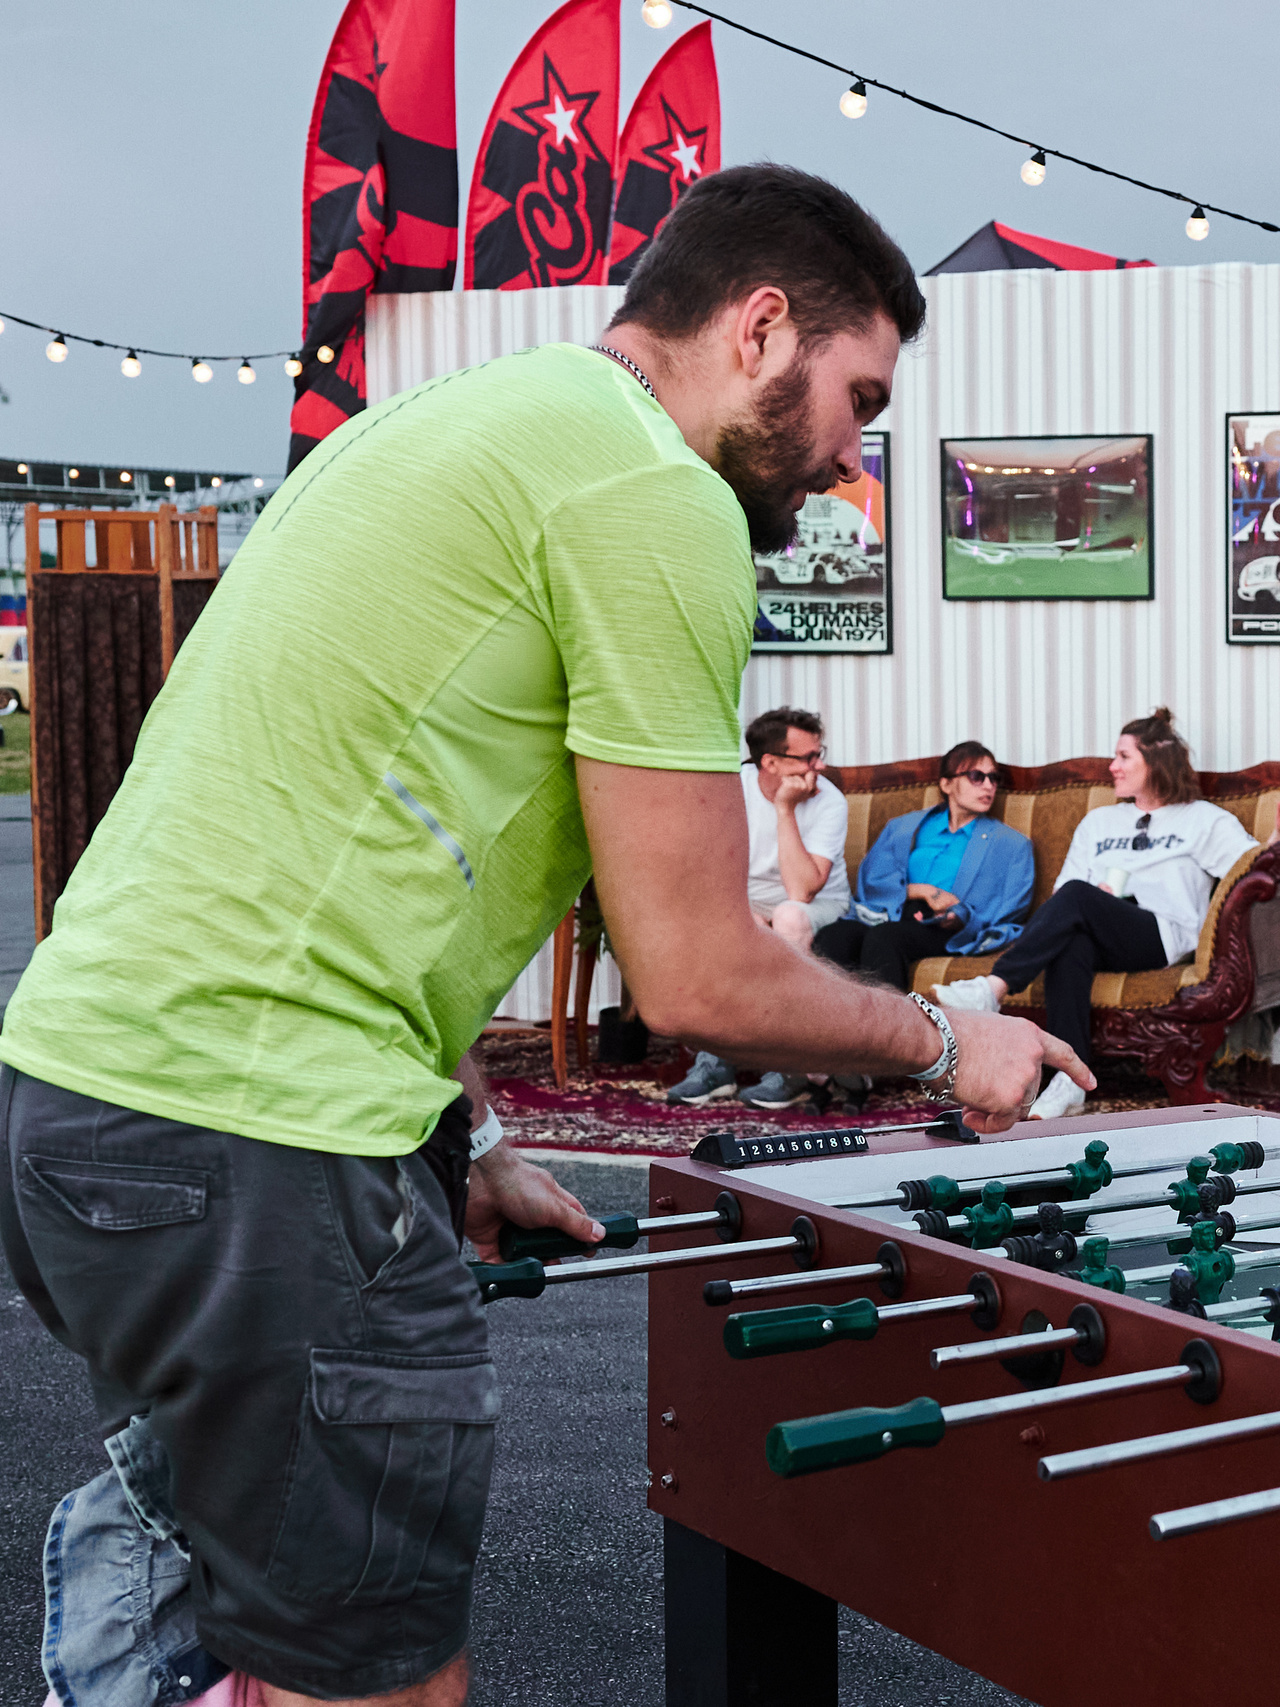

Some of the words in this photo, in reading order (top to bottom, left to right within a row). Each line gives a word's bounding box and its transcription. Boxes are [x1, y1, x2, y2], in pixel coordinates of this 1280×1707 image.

[769, 602, 796, 614] 24
[799, 602, 884, 614] HEURES
[790, 614, 819, 628] DU
[823, 614, 884, 628] MANS
[798, 629, 842, 641] JUIN
[844, 629, 884, 641] 1971
[738, 1147, 746, 1157] 1
[751, 1145, 760, 1156] 2
[765, 1144, 774, 1154] 3
[778, 1143, 786, 1153] 4
[790, 1141, 799, 1152] 5
[804, 1140, 812, 1150] 6
[816, 1139, 824, 1149] 7
[829, 1137, 838, 1148] 8
[843, 1135, 851, 1146] 9
[854, 1135, 866, 1145] 10
